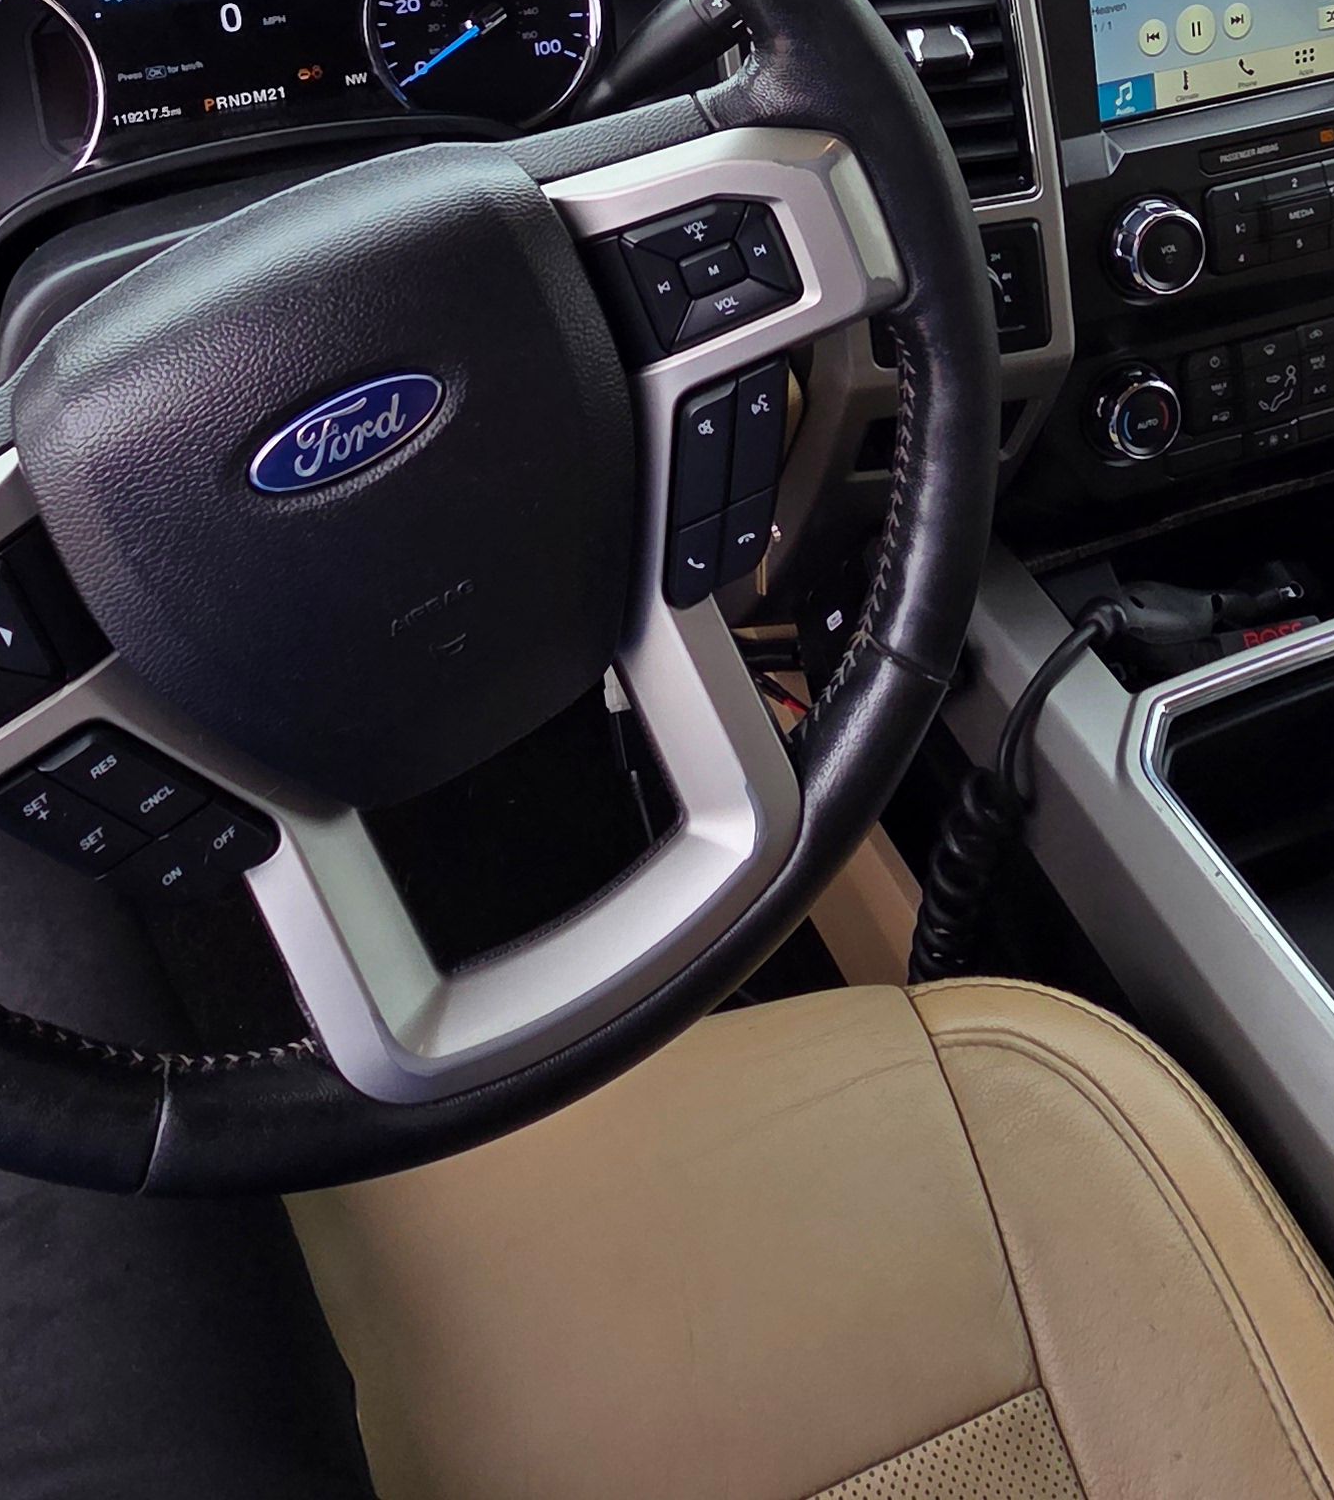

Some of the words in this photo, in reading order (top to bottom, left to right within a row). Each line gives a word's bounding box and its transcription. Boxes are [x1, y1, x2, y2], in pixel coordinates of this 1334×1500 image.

[220, 2, 242, 32] 0
[262, 14, 286, 25] MPH
[1091, 1, 1127, 17] Heaven
[534, 39, 562, 56] 100
[117, 72, 143, 82] Press
[345, 73, 367, 86] NW
[1298, 67, 1314, 77] Apps
[1237, 80, 1258, 89] Phone
[1175, 92, 1199, 103] Climate
[1115, 105, 1137, 116] Audio
[1219, 147, 1256, 164] PASSENGER
[1256, 143, 1279, 157] AIRBAG
[1233, 191, 1239, 201] 1
[1290, 177, 1298, 188] 2
[1288, 206, 1315, 221] MEDIA
[683, 220, 708, 235] VOL
[1160, 243, 1177, 255] VOL
[1237, 254, 1245, 263] 4
[1295, 238, 1303, 249] 5
[707, 264, 720, 276] M
[714, 296, 739, 311] VOL
[1136, 417, 1158, 430] AUTO
[293, 392, 406, 478] Ford
[89, 753, 118, 780] RES
[22, 791, 50, 817] SET
[139, 785, 176, 815] CNCL
[79, 826, 105, 851] SET
[212, 825, 238, 850] OFF
[161, 865, 183, 887] ON
